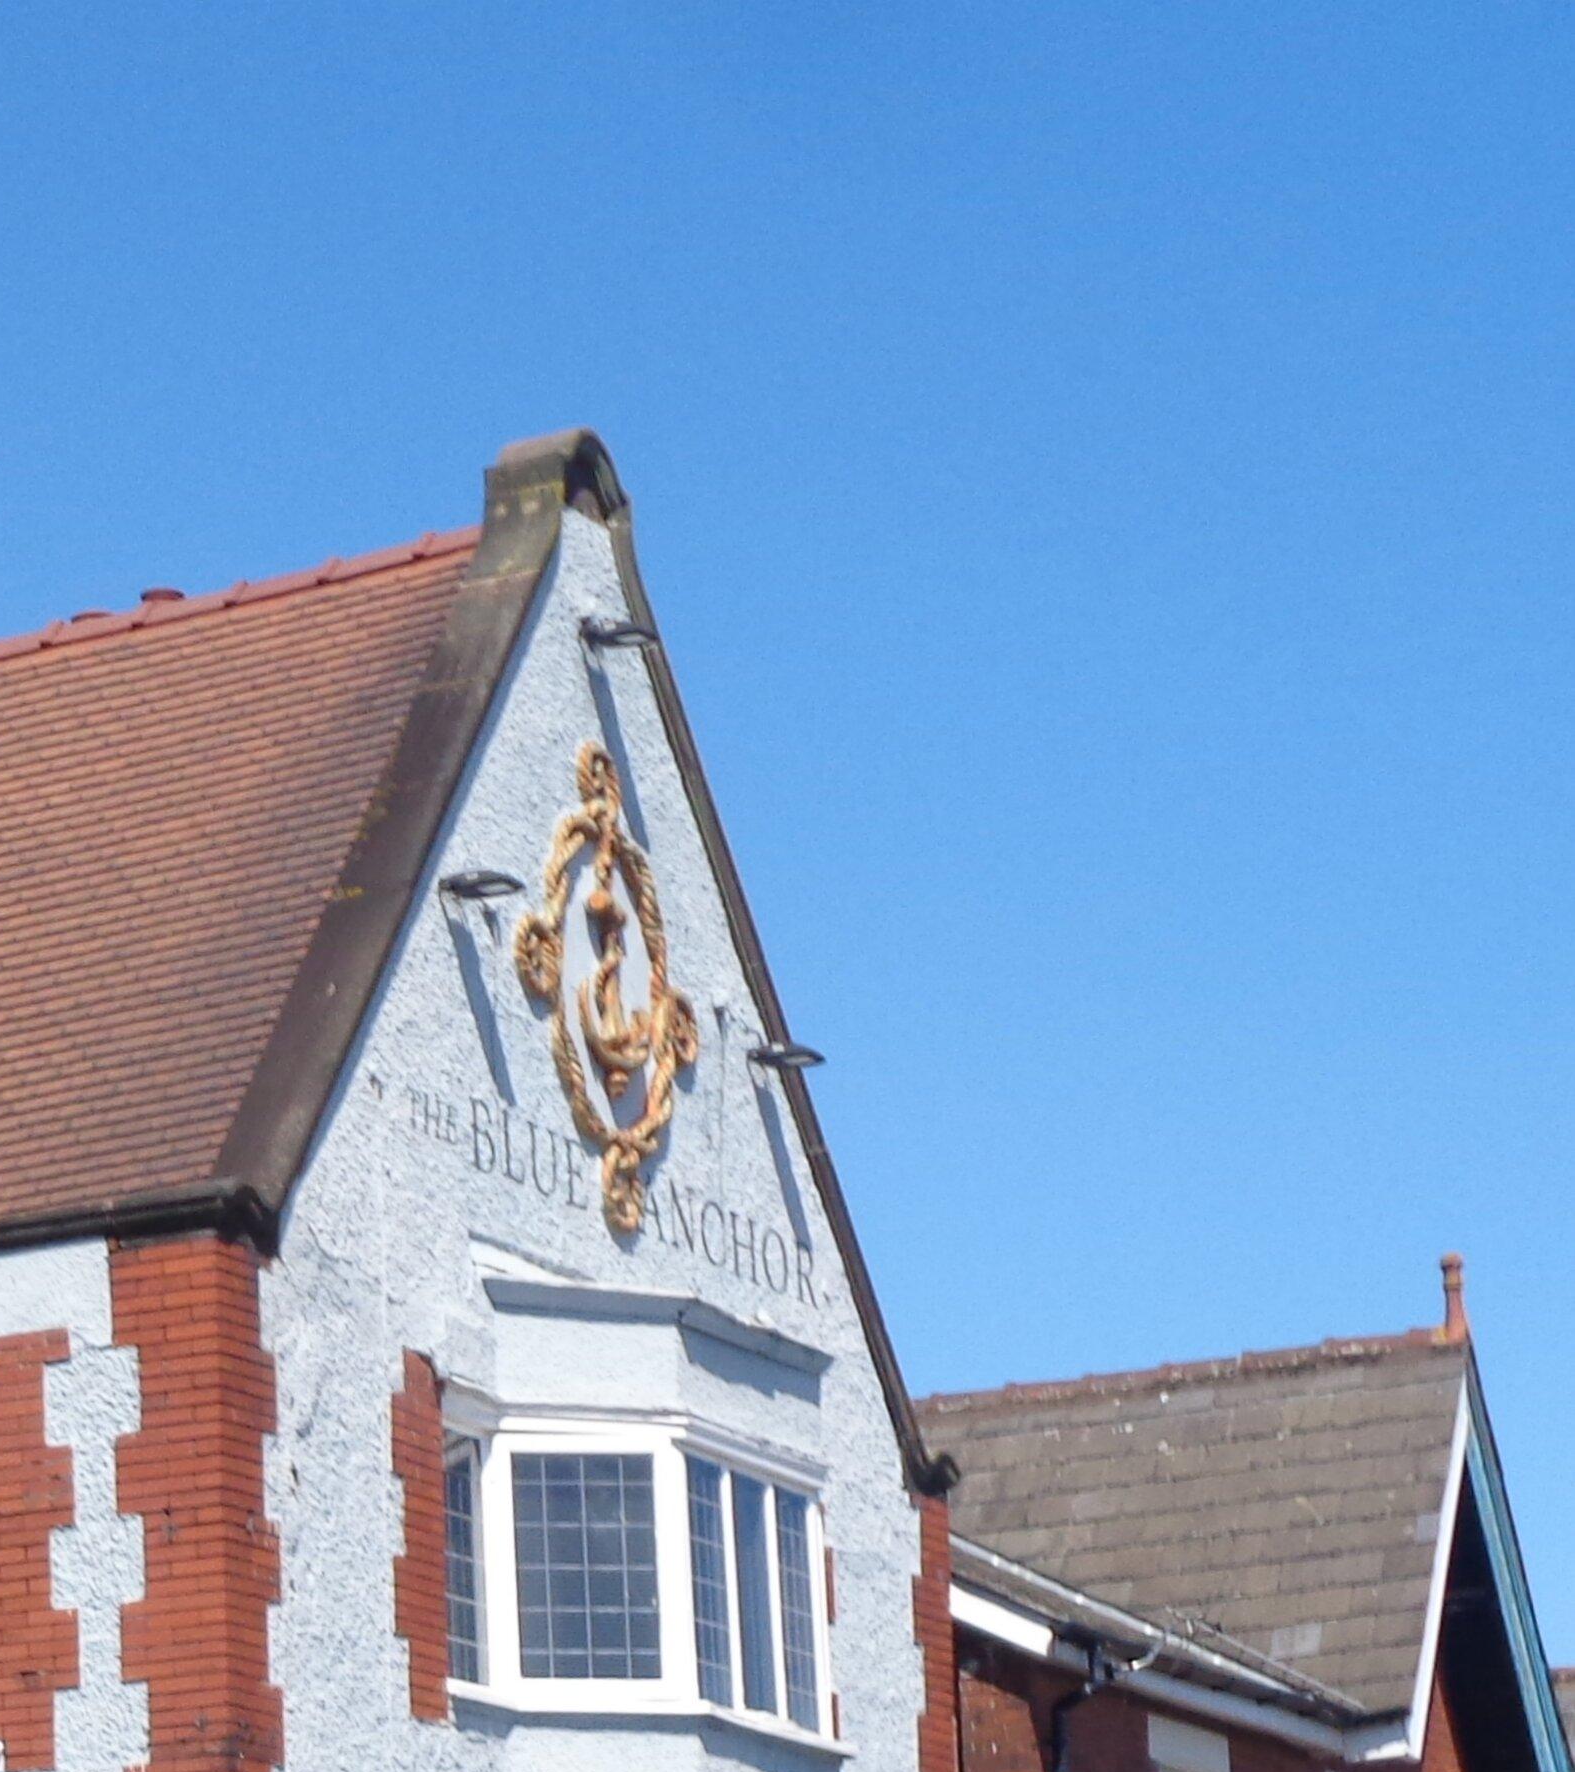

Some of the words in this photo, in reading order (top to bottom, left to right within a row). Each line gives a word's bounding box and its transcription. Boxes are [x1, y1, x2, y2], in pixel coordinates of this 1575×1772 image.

[406, 1084, 458, 1145] THE
[469, 1095, 588, 1211] BLUE
[645, 1178, 820, 1310] ANCHOR
